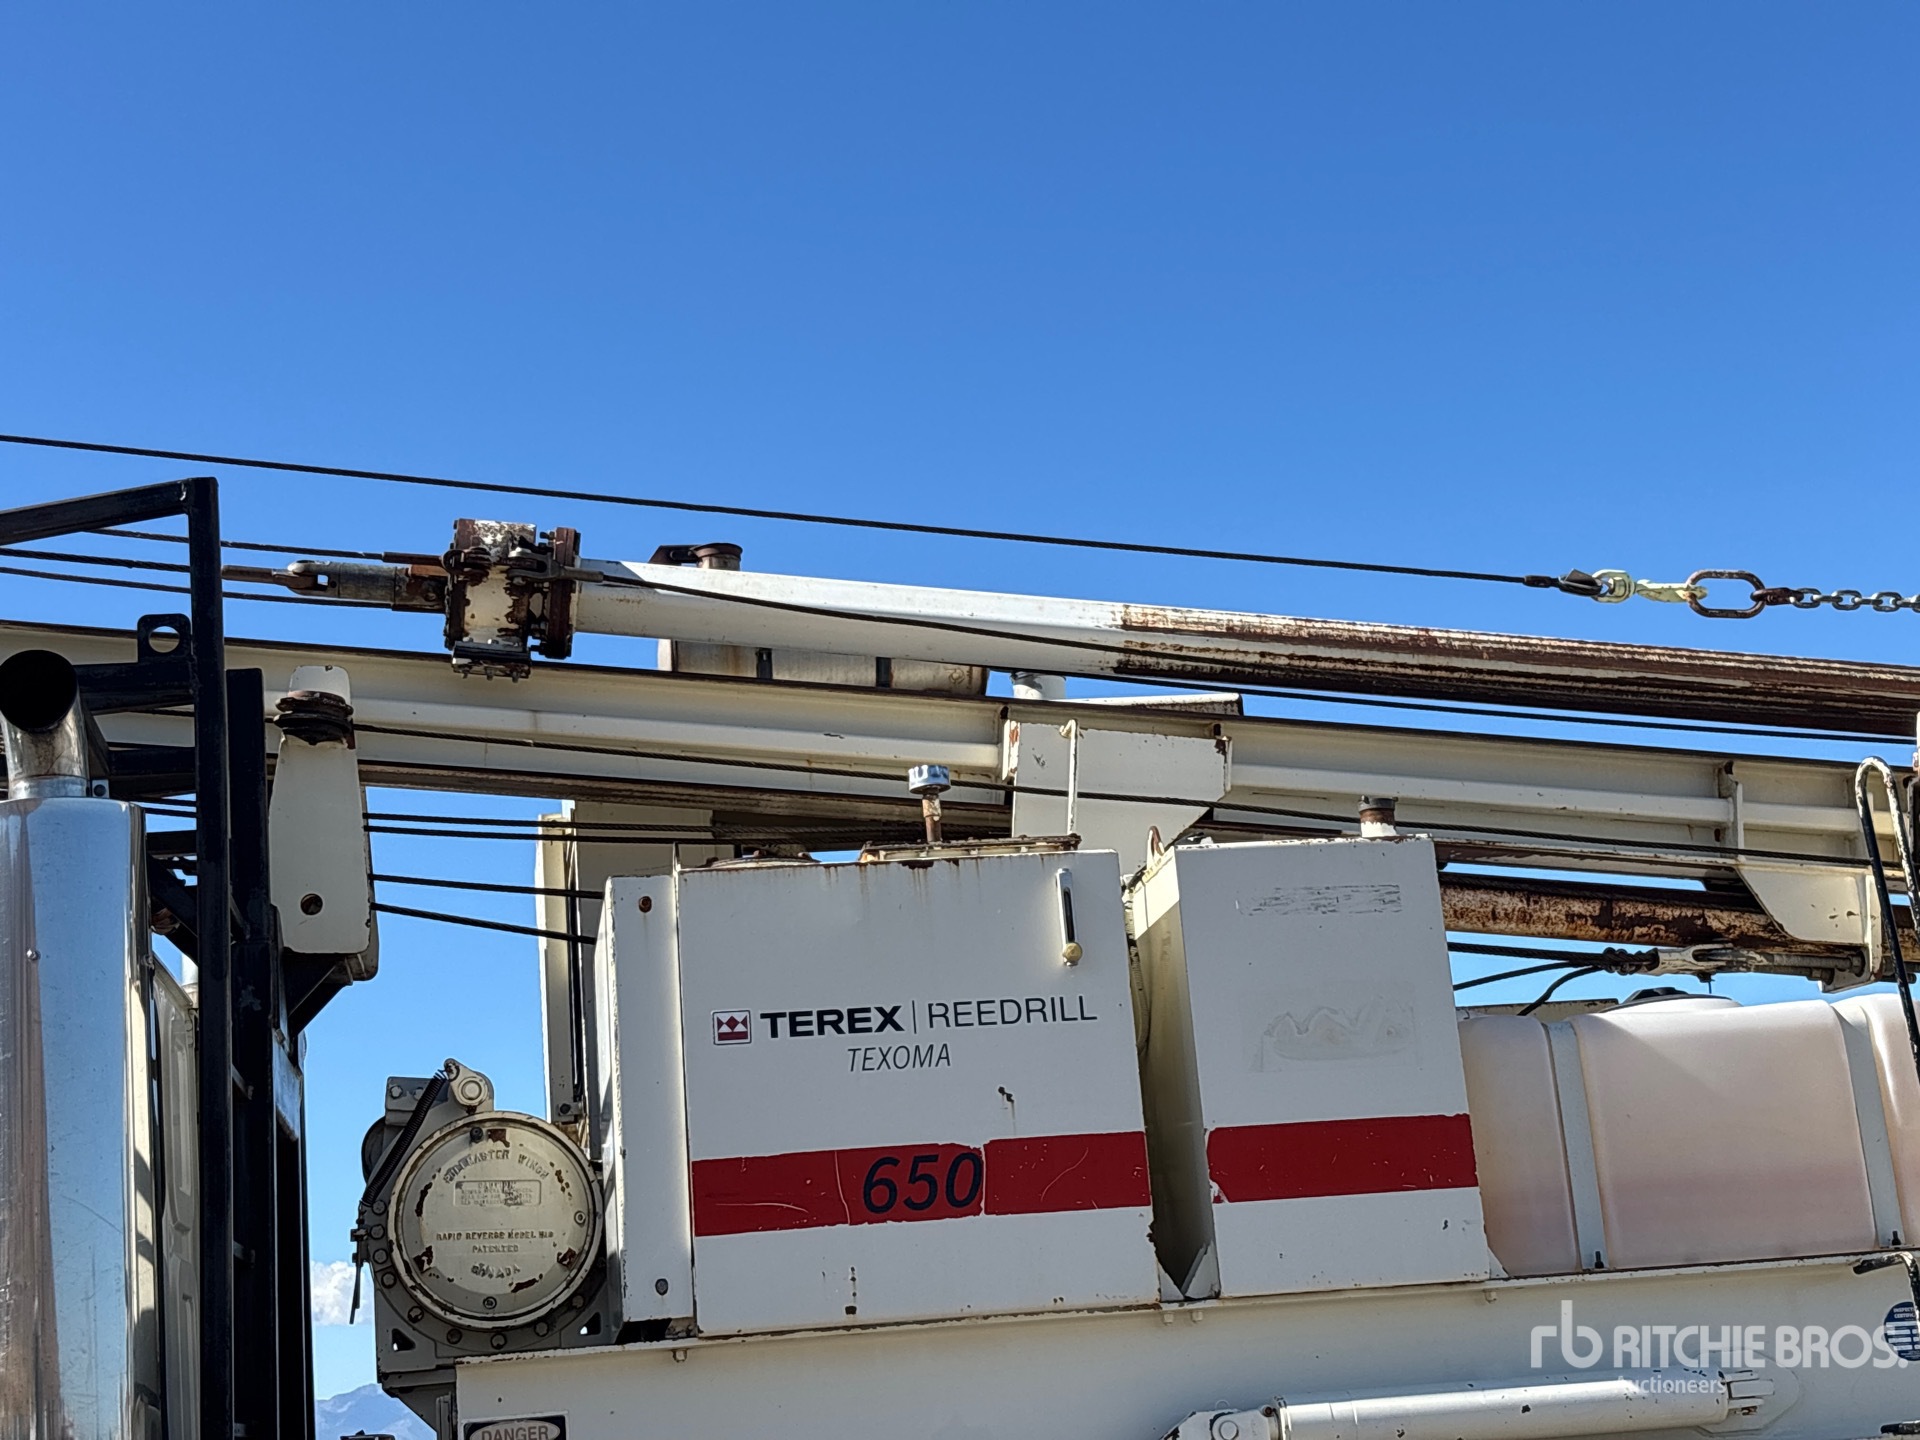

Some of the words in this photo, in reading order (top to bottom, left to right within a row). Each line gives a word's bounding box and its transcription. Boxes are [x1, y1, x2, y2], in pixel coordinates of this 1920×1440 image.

[760, 1004, 904, 1039] TEREX
[928, 995, 1098, 1029] REEDRILL
[847, 1042, 951, 1073] TEXOMA
[518, 1153, 550, 1179] WINCH
[862, 1152, 984, 1214] 650
[436, 1232, 462, 1241] RAPID
[465, 1231, 505, 1240] REVERSE
[507, 1230, 536, 1239] MODEL
[472, 1244, 519, 1253] PATENTED
[471, 1262, 521, 1279] CANADA
[481, 1425, 549, 1440] DANGER
